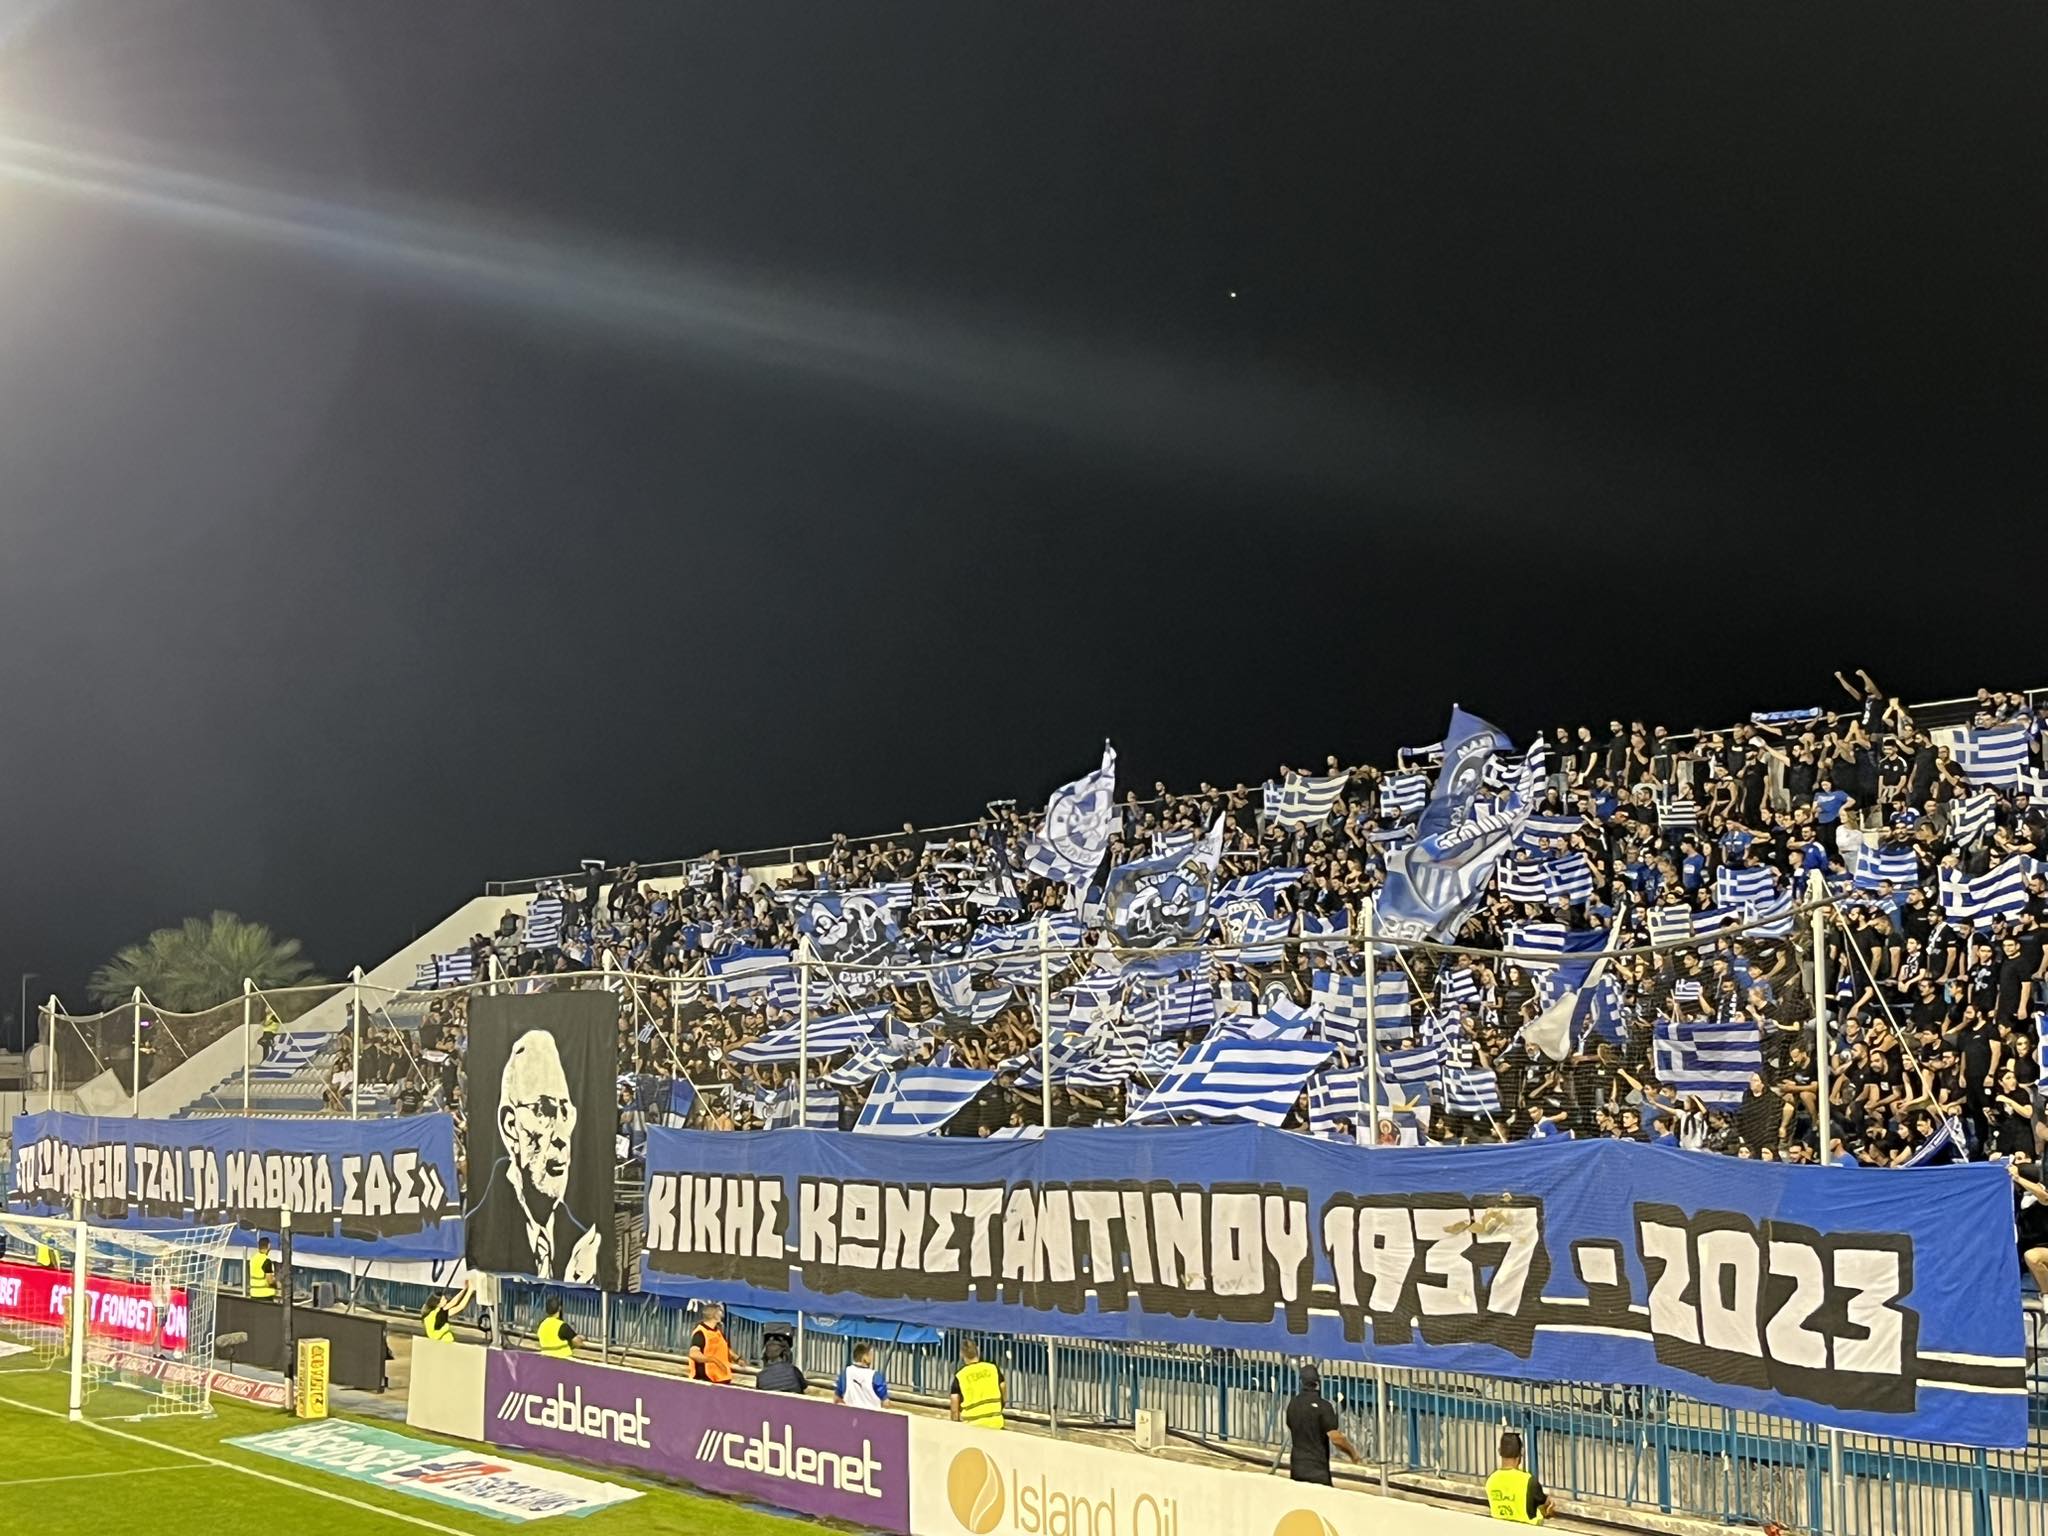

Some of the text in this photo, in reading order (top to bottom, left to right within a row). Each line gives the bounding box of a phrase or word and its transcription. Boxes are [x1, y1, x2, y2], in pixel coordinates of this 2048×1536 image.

[134, 1147, 183, 1203] ΤΖΑΙ
[189, 1149, 220, 1210] ΤΑ
[646, 1174, 783, 1259] ΚΙΚΗΣ
[800, 1183, 1307, 1302] ΚΩΝΣΤΑΝΤΙΝΟΥ
[1324, 1206, 1539, 1317] 1937
[1640, 1221, 1903, 1375] 2023
[100, 1293, 156, 1332] FONBET
[523, 1382, 651, 1449] cablenet
[722, 1421, 882, 1498] cablenet
[1013, 1468, 1178, 1536] Island Oil
